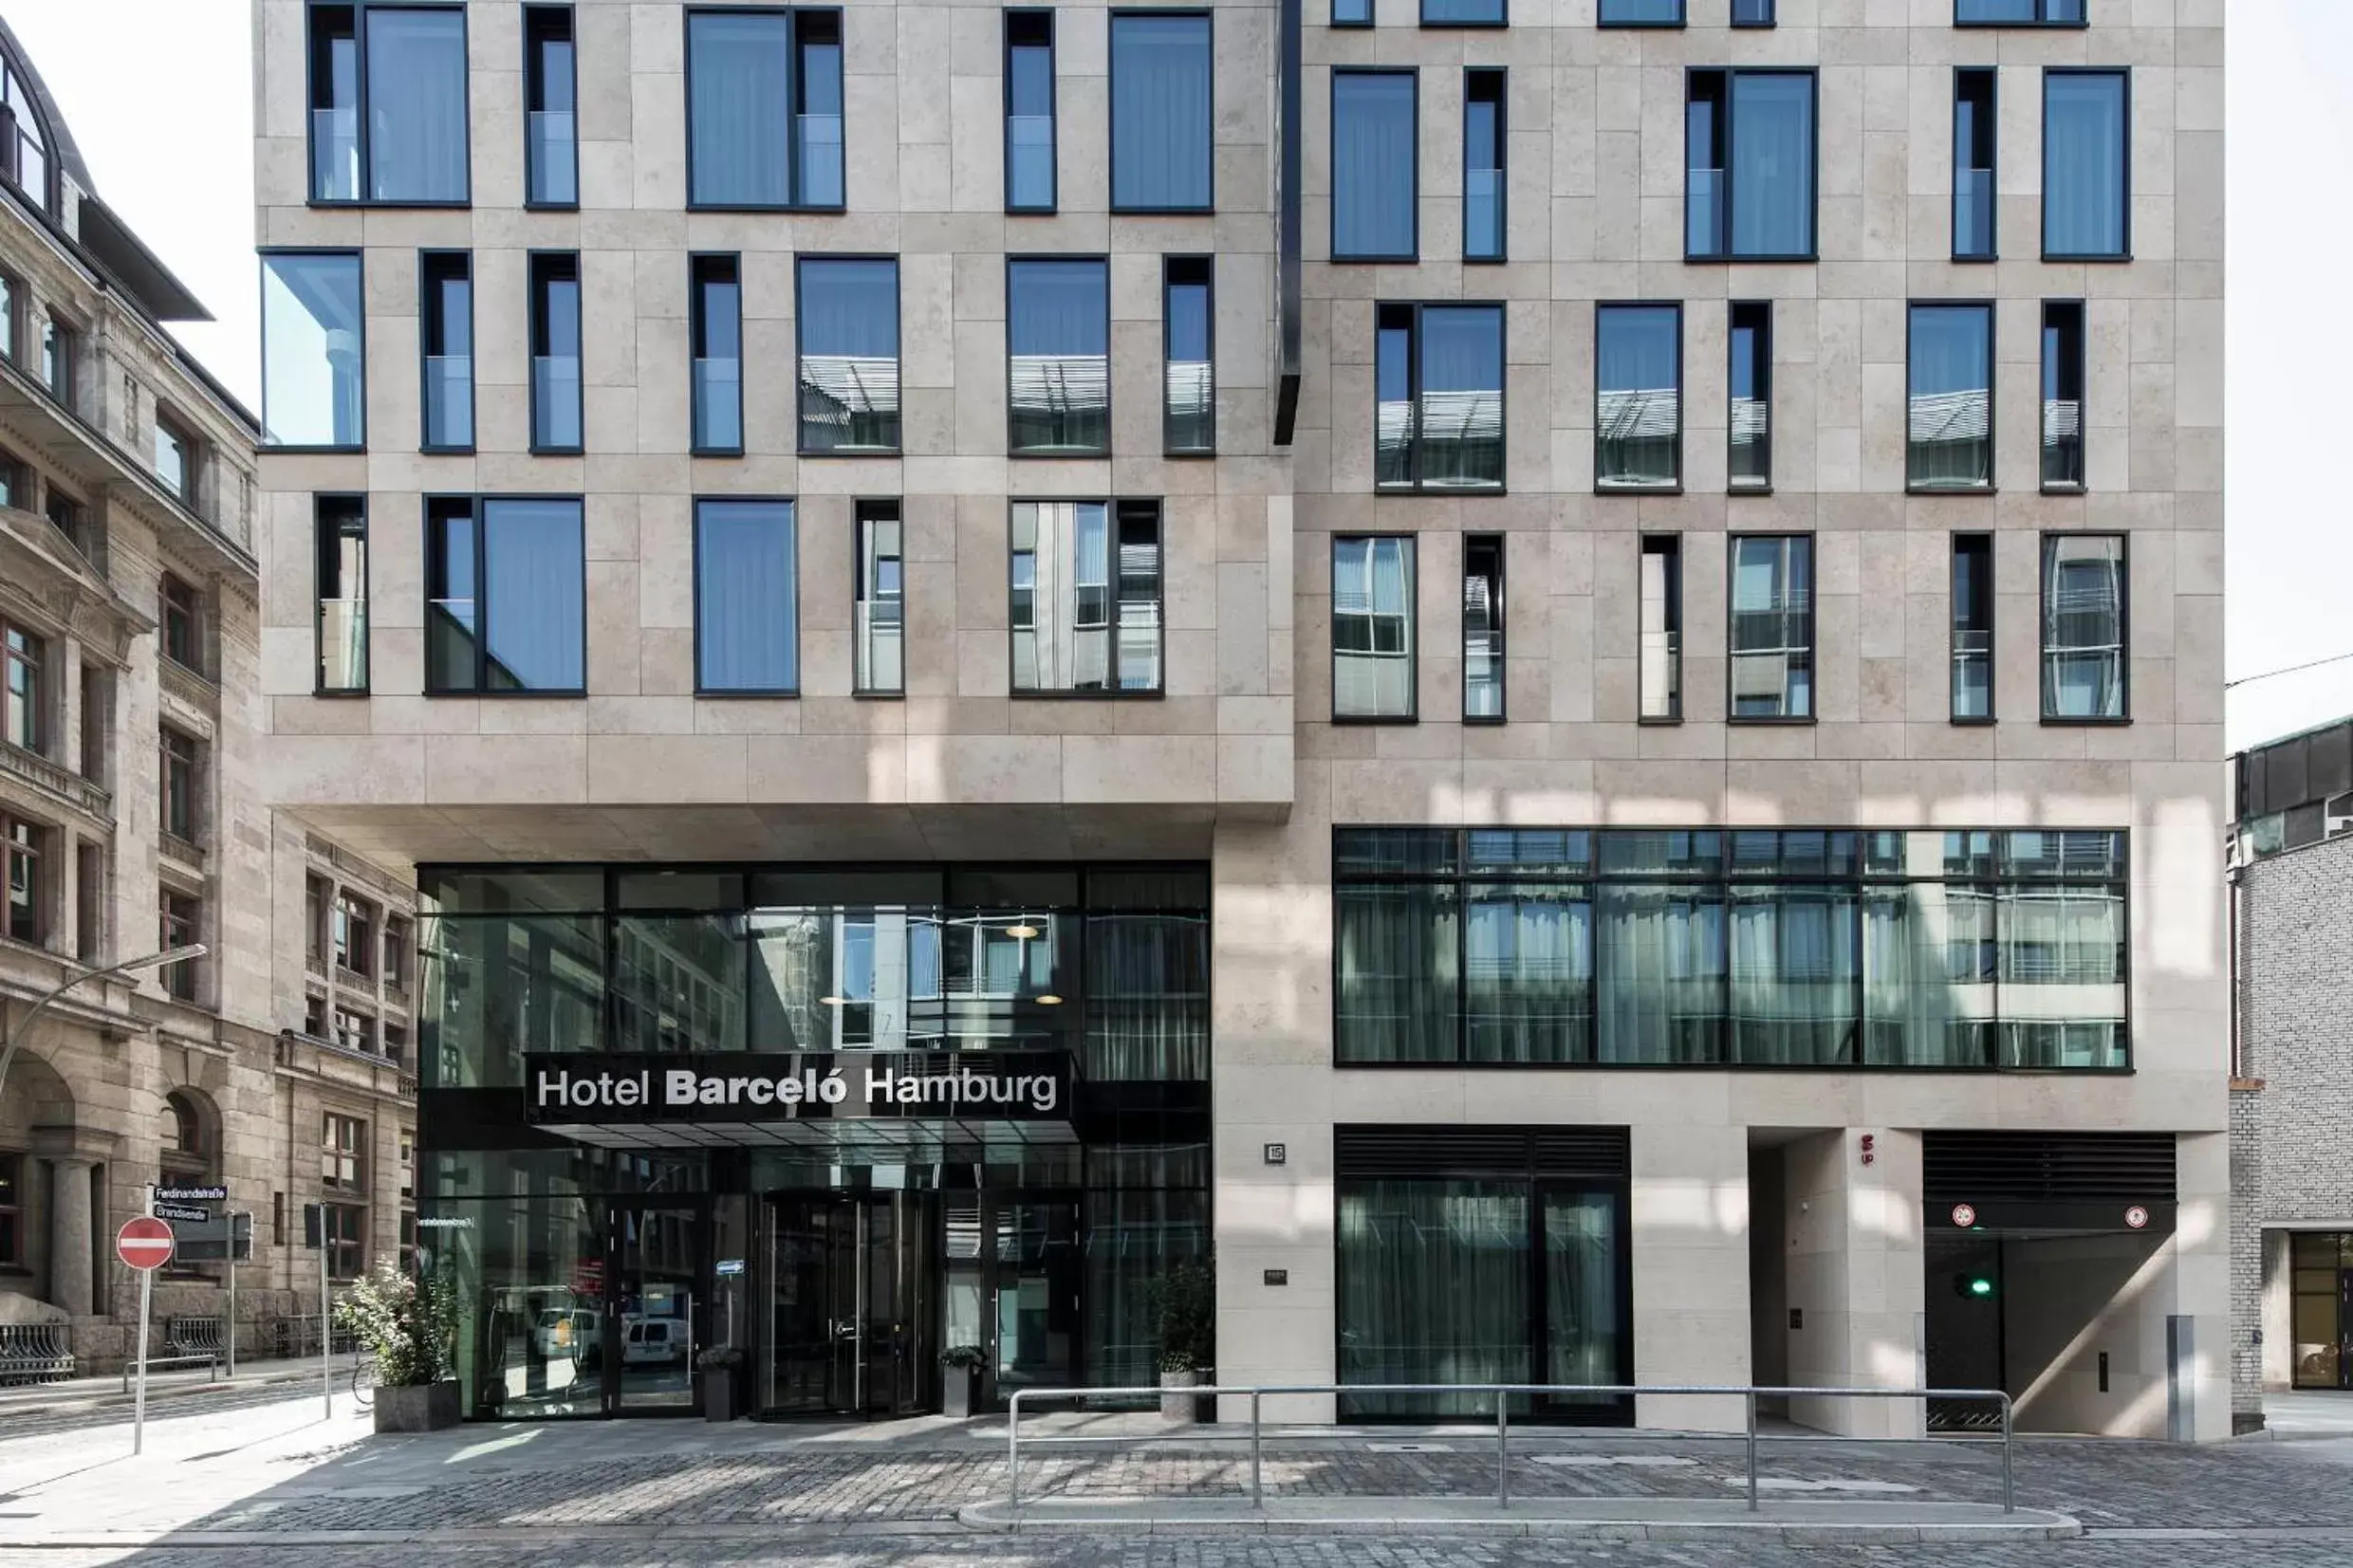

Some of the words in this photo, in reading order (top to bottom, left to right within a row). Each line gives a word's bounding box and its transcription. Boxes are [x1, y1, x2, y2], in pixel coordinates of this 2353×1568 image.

[538, 1070, 649, 1106] Hotel
[666, 1067, 847, 1106] Barceló
[864, 1067, 1057, 1111] Hamburg
[156, 1187, 225, 1199] Ferdinandstraße
